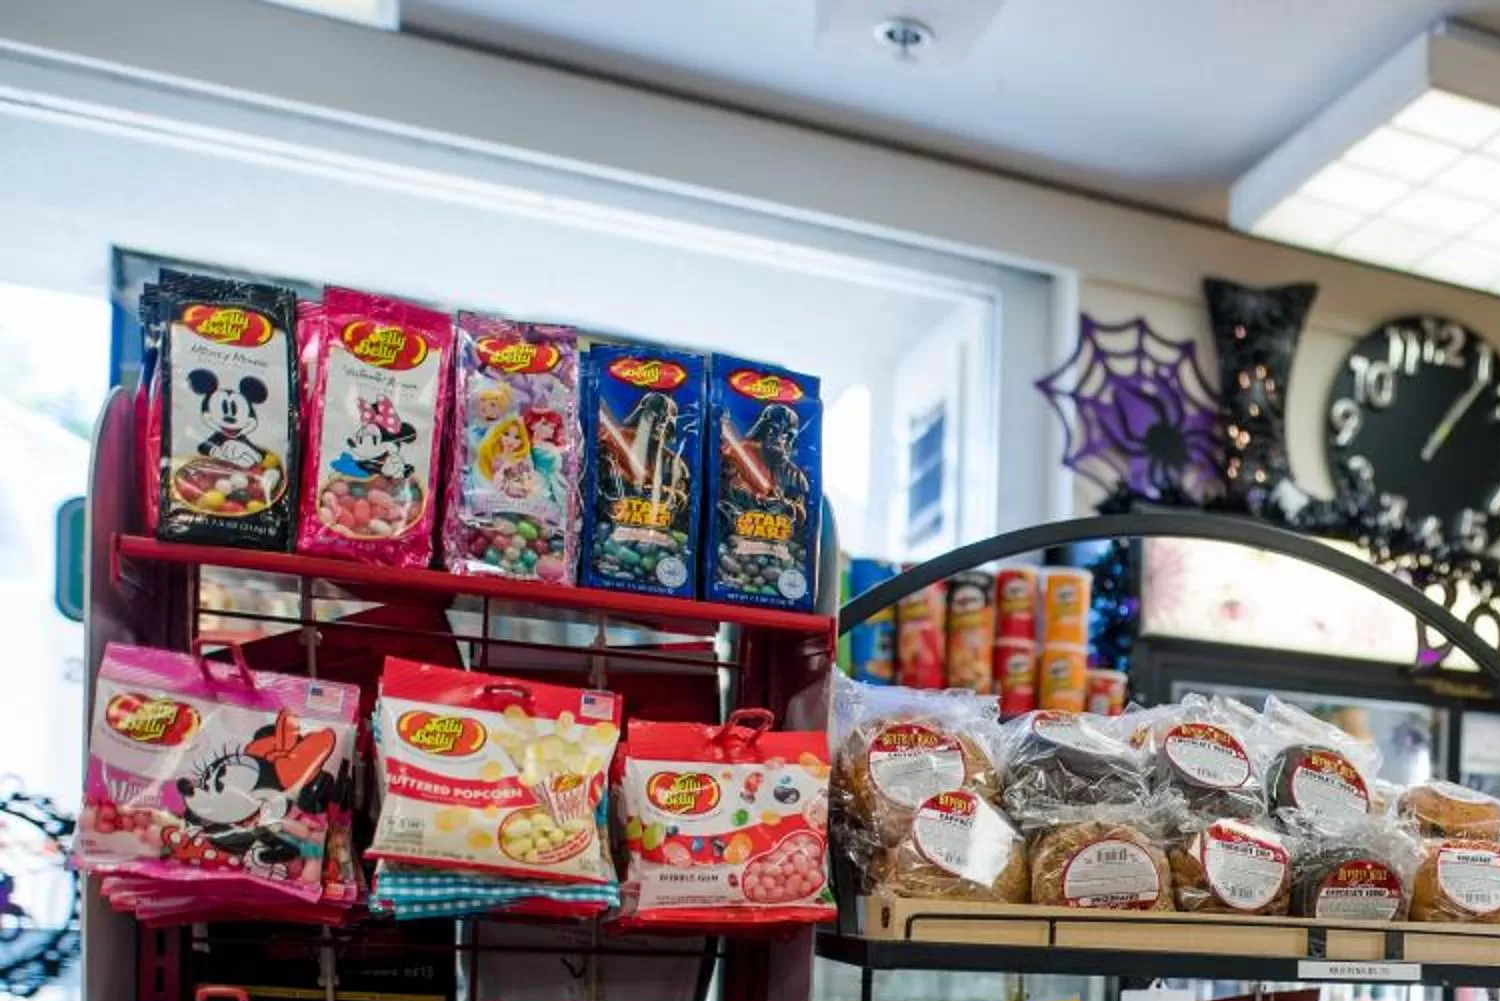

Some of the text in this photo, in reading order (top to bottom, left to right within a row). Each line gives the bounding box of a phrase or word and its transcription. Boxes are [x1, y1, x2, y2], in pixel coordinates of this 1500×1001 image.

[1350, 354, 1395, 407] 10
[1331, 398, 1361, 446] 9
[1459, 507, 1488, 553] 5
[410, 731, 456, 754] Belly
[425, 716, 463, 737] Jelly
[452, 784, 524, 801] POPCORN
